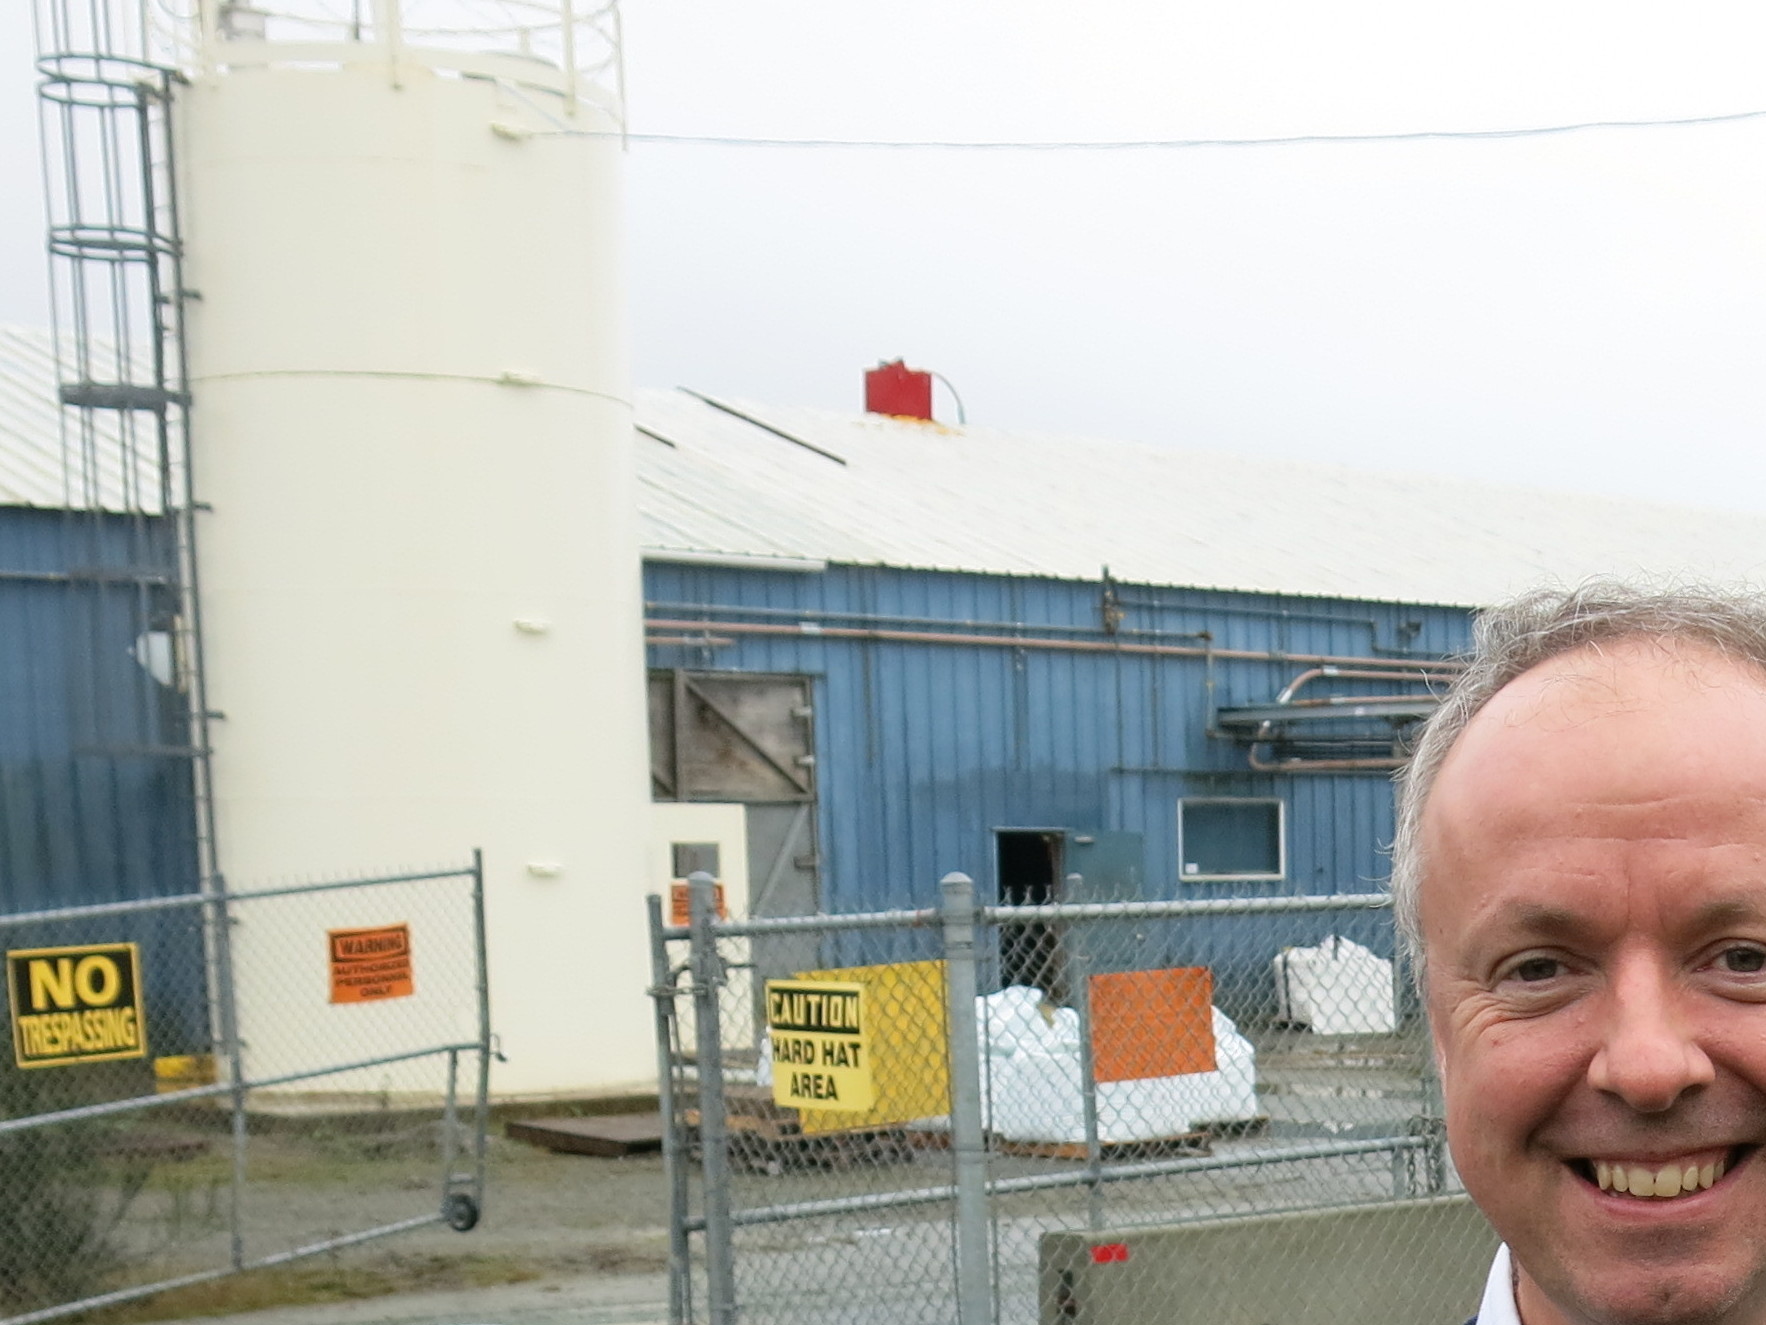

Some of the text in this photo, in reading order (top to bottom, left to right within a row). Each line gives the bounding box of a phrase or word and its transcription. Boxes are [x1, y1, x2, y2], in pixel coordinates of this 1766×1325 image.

[341, 933, 403, 955] WARNING
[29, 955, 119, 1010] NO
[769, 992, 859, 1029] CAUTION
[18, 1006, 137, 1056] TRESPASSING
[772, 1037, 861, 1067] HARD HAT
[790, 1072, 839, 1100] AREA
